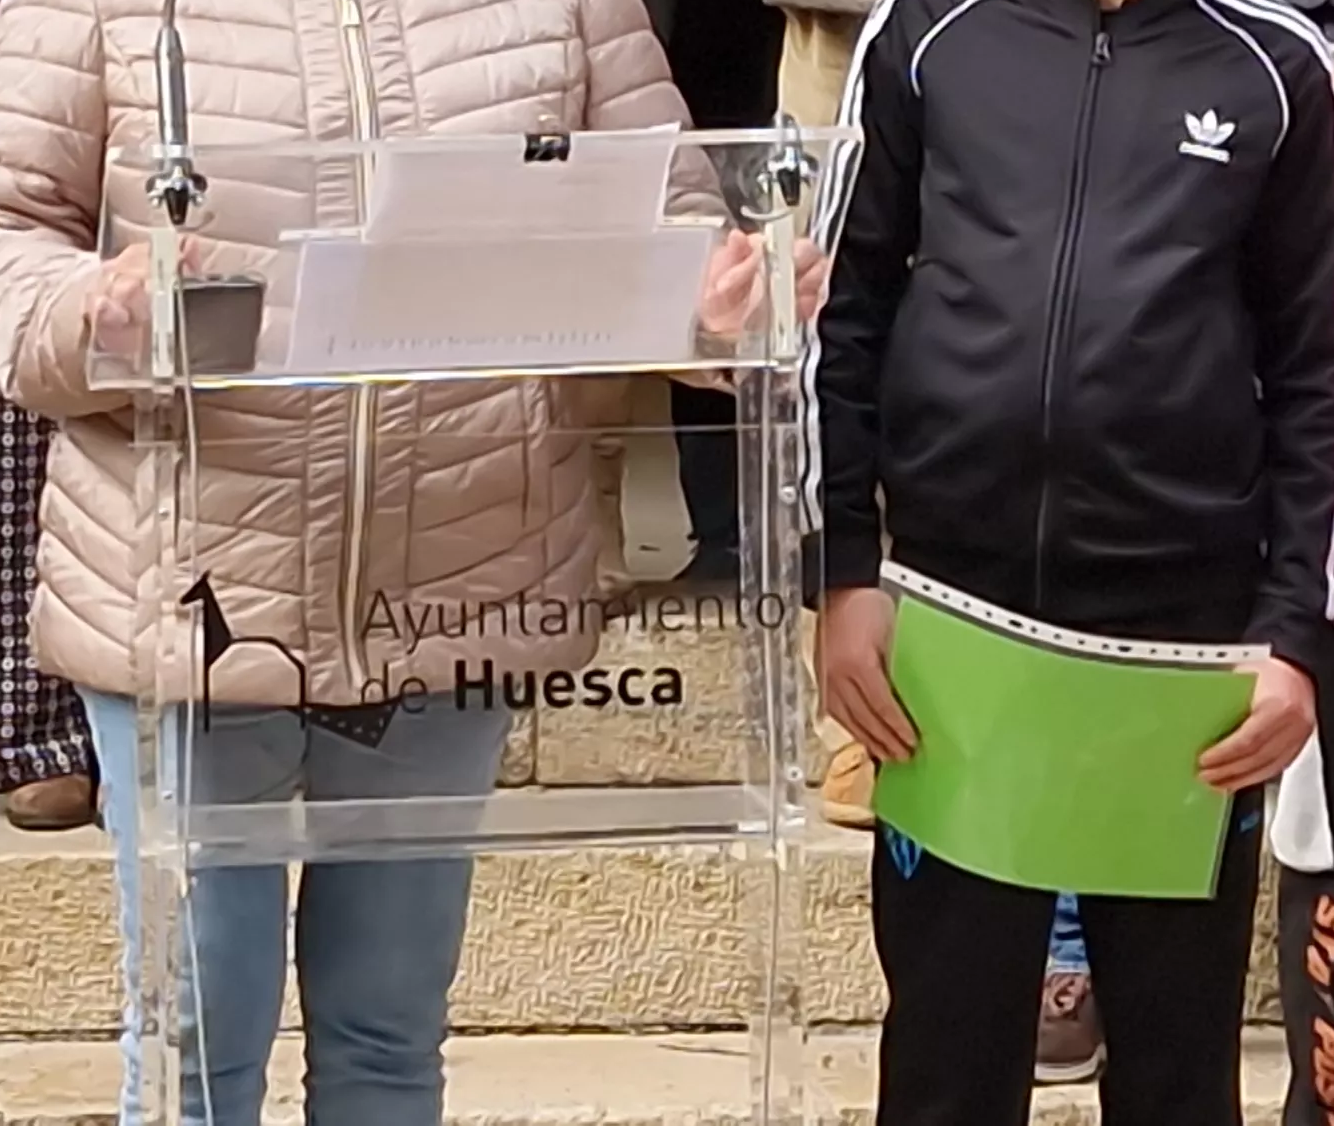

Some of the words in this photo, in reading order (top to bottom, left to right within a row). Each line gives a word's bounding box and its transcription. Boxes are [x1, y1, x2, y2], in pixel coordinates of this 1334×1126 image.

[362, 587, 786, 655] Ayuntamiento
[359, 663, 426, 715] de
[454, 658, 684, 710] Huesca
